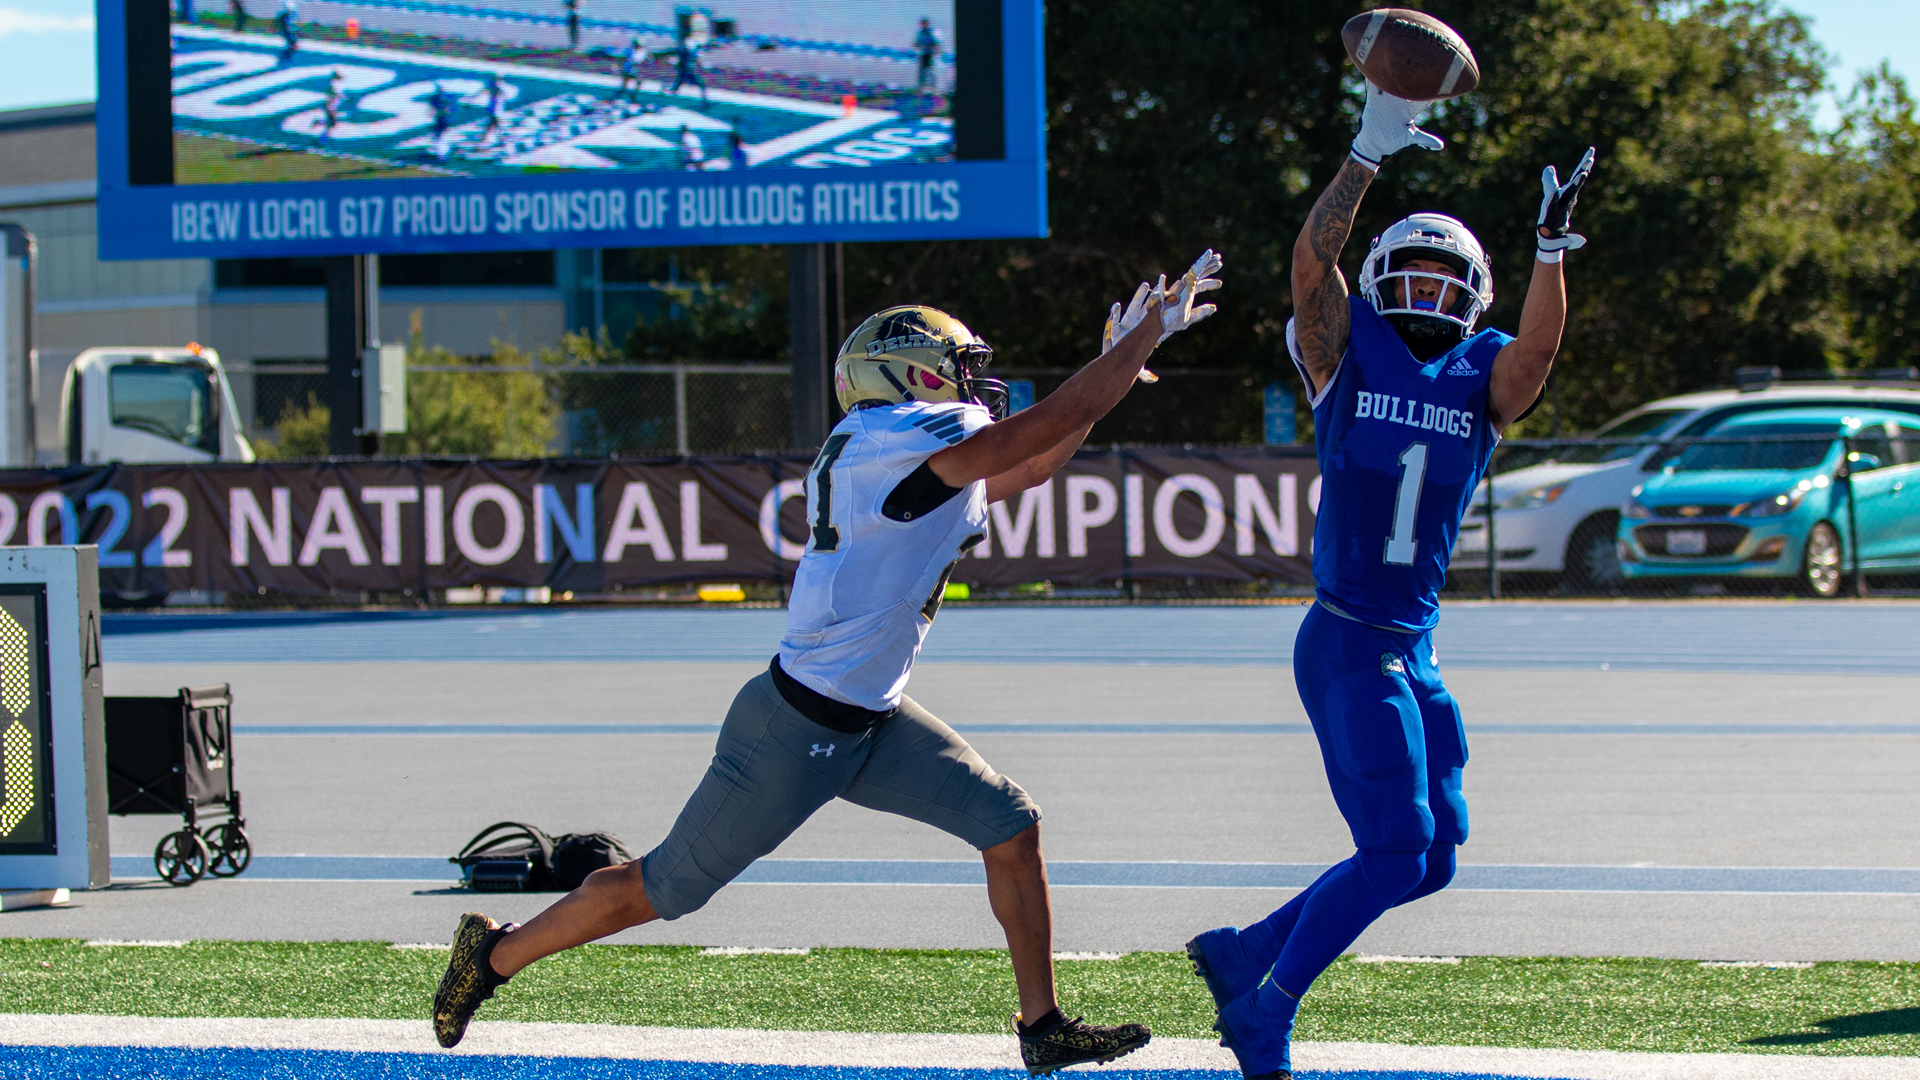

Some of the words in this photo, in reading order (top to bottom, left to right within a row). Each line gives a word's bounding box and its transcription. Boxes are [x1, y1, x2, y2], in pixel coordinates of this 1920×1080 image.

[171, 201, 242, 242] IBEW
[248, 198, 333, 240] LOCAL
[339, 196, 386, 238] 617
[392, 193, 488, 236] PROUD
[494, 189, 627, 233] SPONSOR
[634, 187, 670, 230] OF
[677, 184, 805, 228] BULLDOG
[813, 180, 961, 224] ATHLETICS
[865, 333, 944, 359] DELTA
[1355, 390, 1474, 439] BULLDOGS
[228, 480, 729, 566] NATIONAL
[1383, 440, 1430, 567] 1
